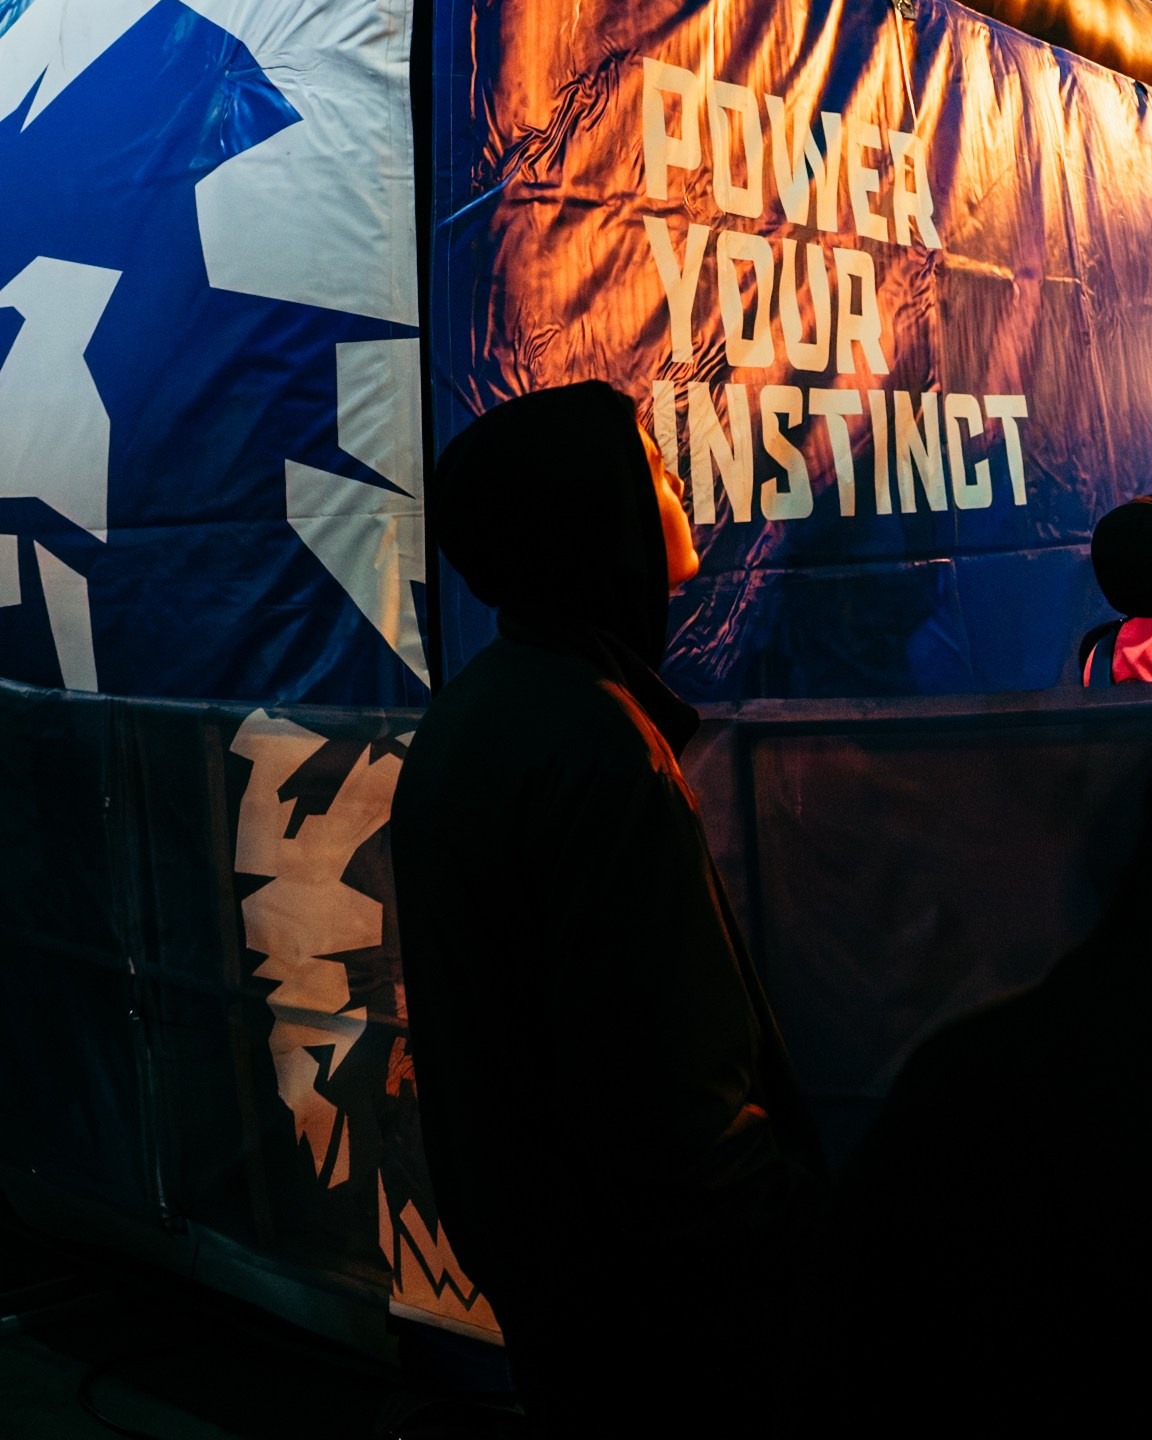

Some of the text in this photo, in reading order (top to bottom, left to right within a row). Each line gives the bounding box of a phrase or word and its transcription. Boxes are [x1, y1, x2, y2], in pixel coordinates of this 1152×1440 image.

[643, 56, 942, 250] POWER
[643, 216, 890, 375] YOUR
[652, 380, 1029, 525] INSTINCT
